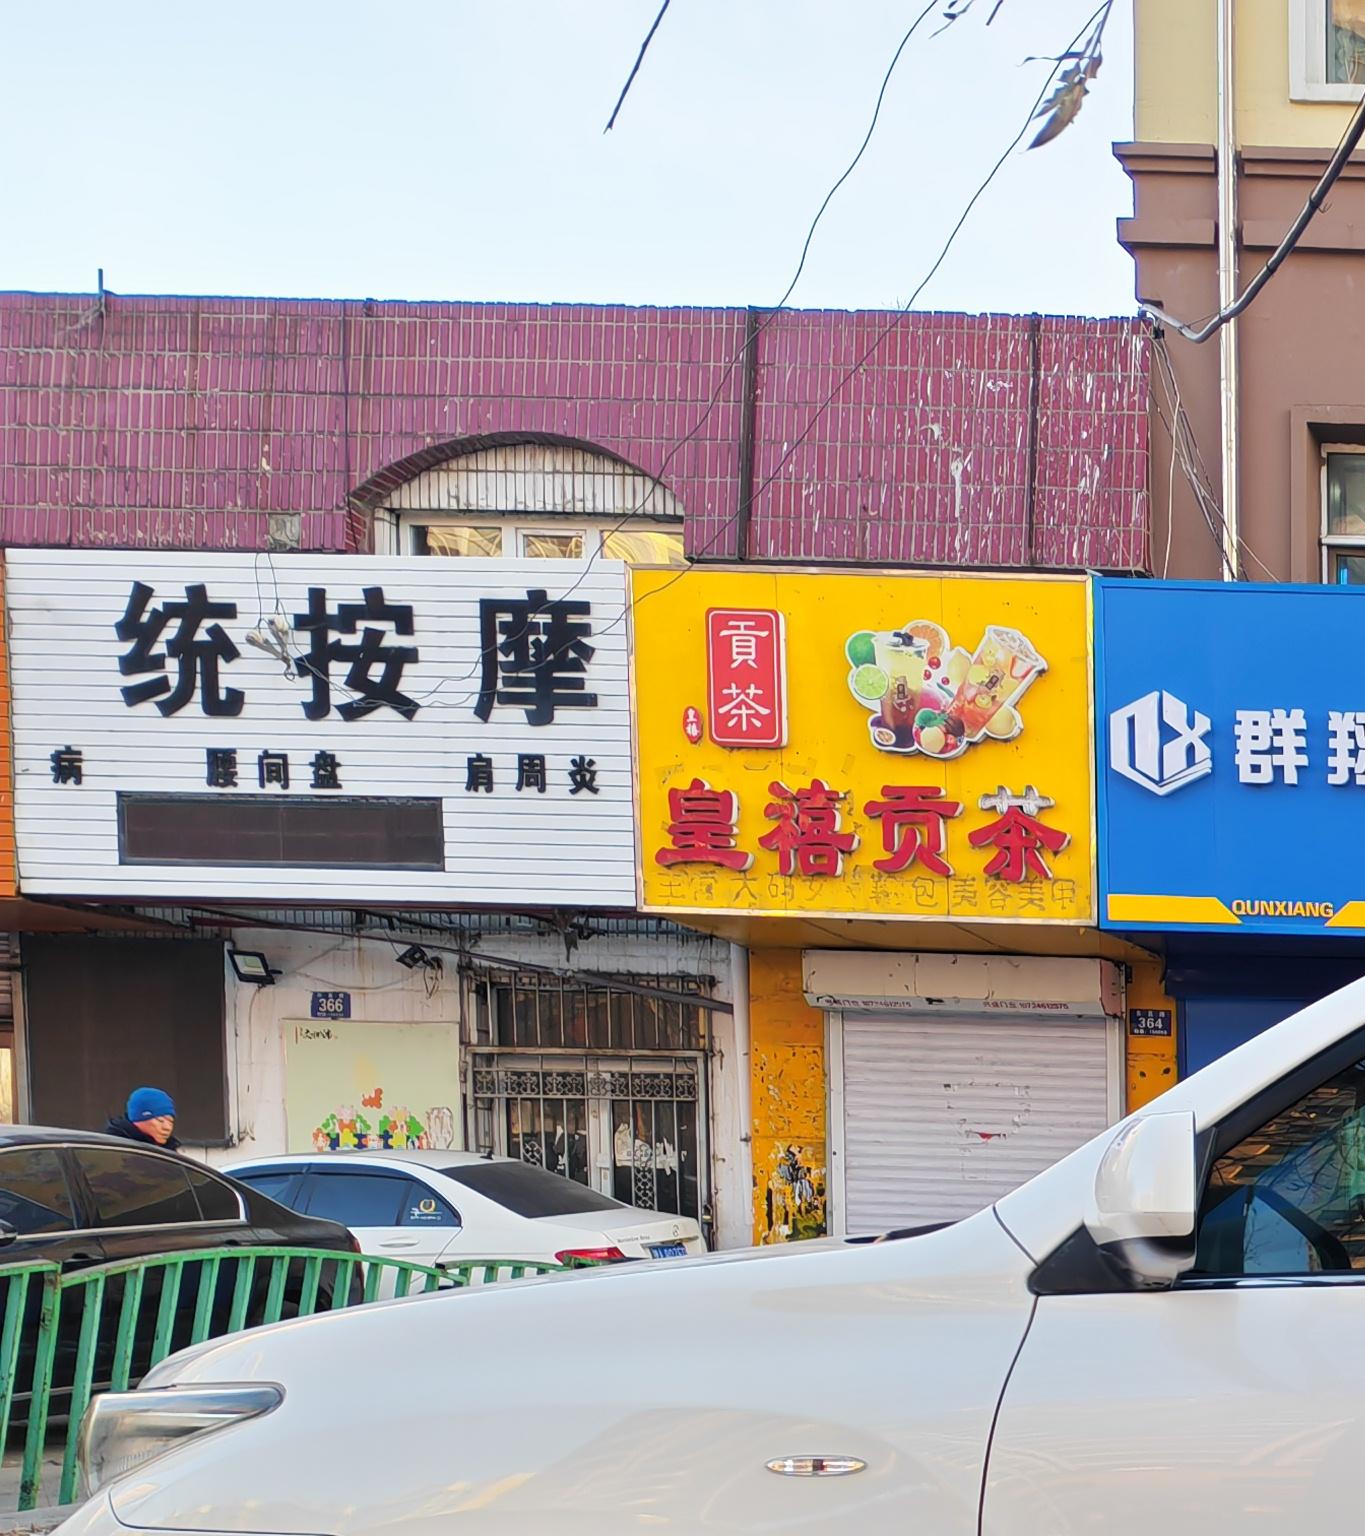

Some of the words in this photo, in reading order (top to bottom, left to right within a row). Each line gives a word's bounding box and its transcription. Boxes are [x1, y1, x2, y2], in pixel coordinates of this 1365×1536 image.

[115, 580, 599, 726] 统按摩
[50, 745, 83, 785] 病
[205, 747, 343, 790] 腰间盘
[464, 752, 600, 795] 肩周炎
[655, 777, 1072, 882] 皇禧贡茶
[1230, 898, 1335, 919] QUNXIANG
[318, 998, 344, 1012] 366
[1137, 1017, 1163, 1029] 364
